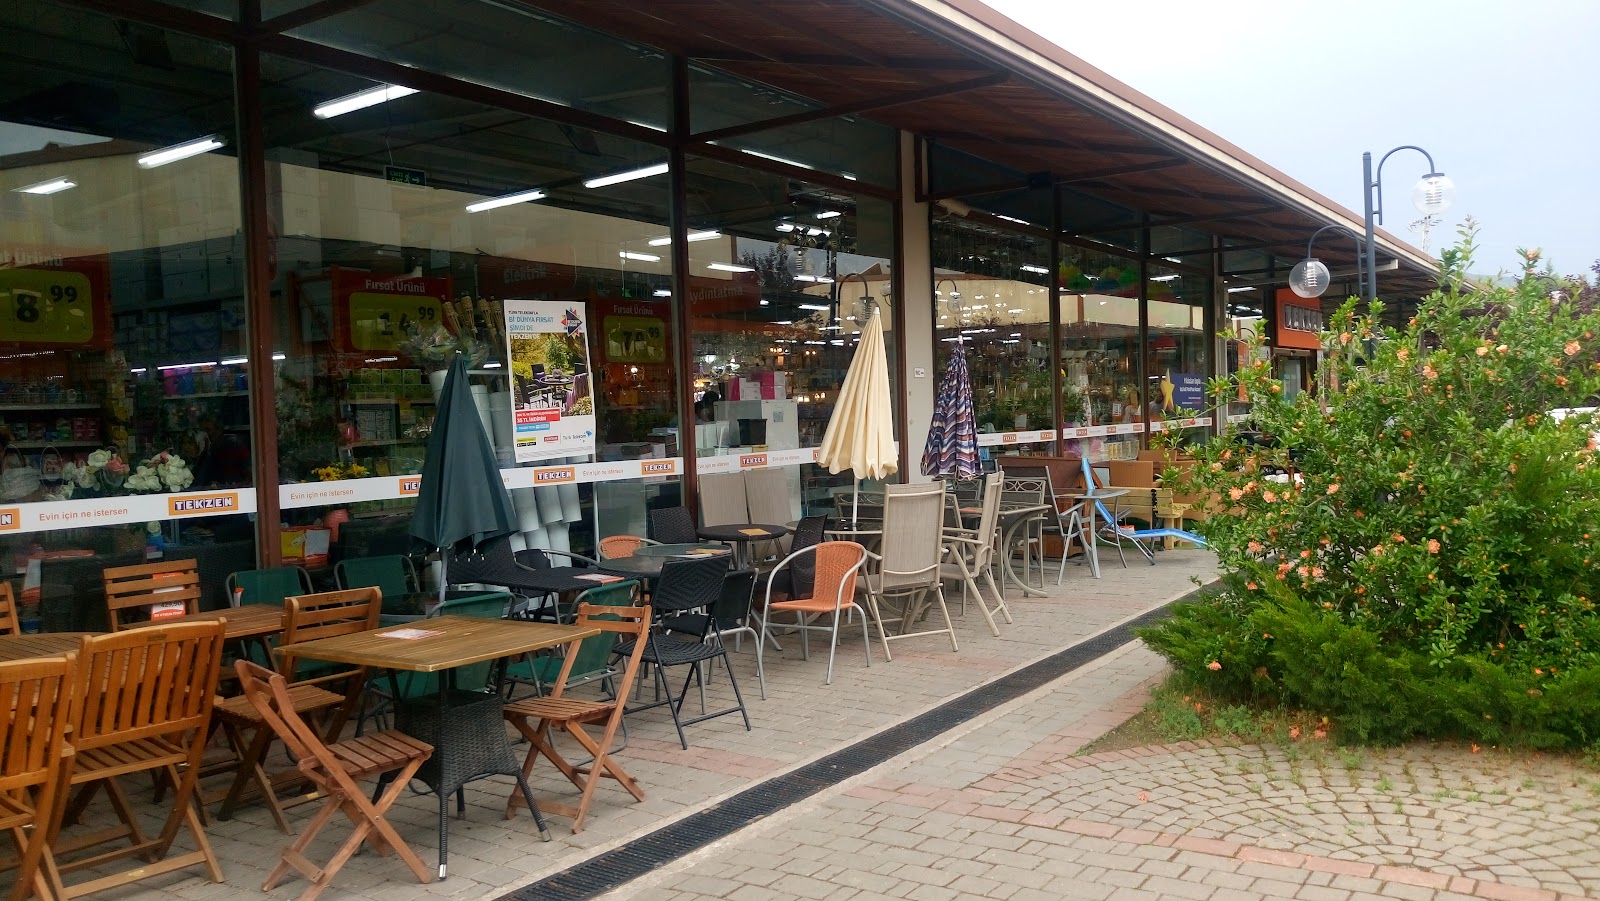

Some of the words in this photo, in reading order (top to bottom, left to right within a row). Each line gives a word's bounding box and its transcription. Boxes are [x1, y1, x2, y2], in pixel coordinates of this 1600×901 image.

[365, 279, 395, 291] Fırsat
[396, 278, 426, 293] Ürünü
[50, 285, 78, 303] 99
[418, 306, 435, 321] 99
[613, 304, 633, 315] Fırsat
[516, 315, 535, 323] DÜNYA
[644, 463, 672, 472] TEKZEN
[537, 470, 572, 480] TEKZEN
[328, 489, 354, 497] istersen
[174, 496, 233, 511] TEKZEN
[39, 512, 59, 521] Evin
[62, 511, 78, 521] için
[94, 508, 128, 517] istersen
